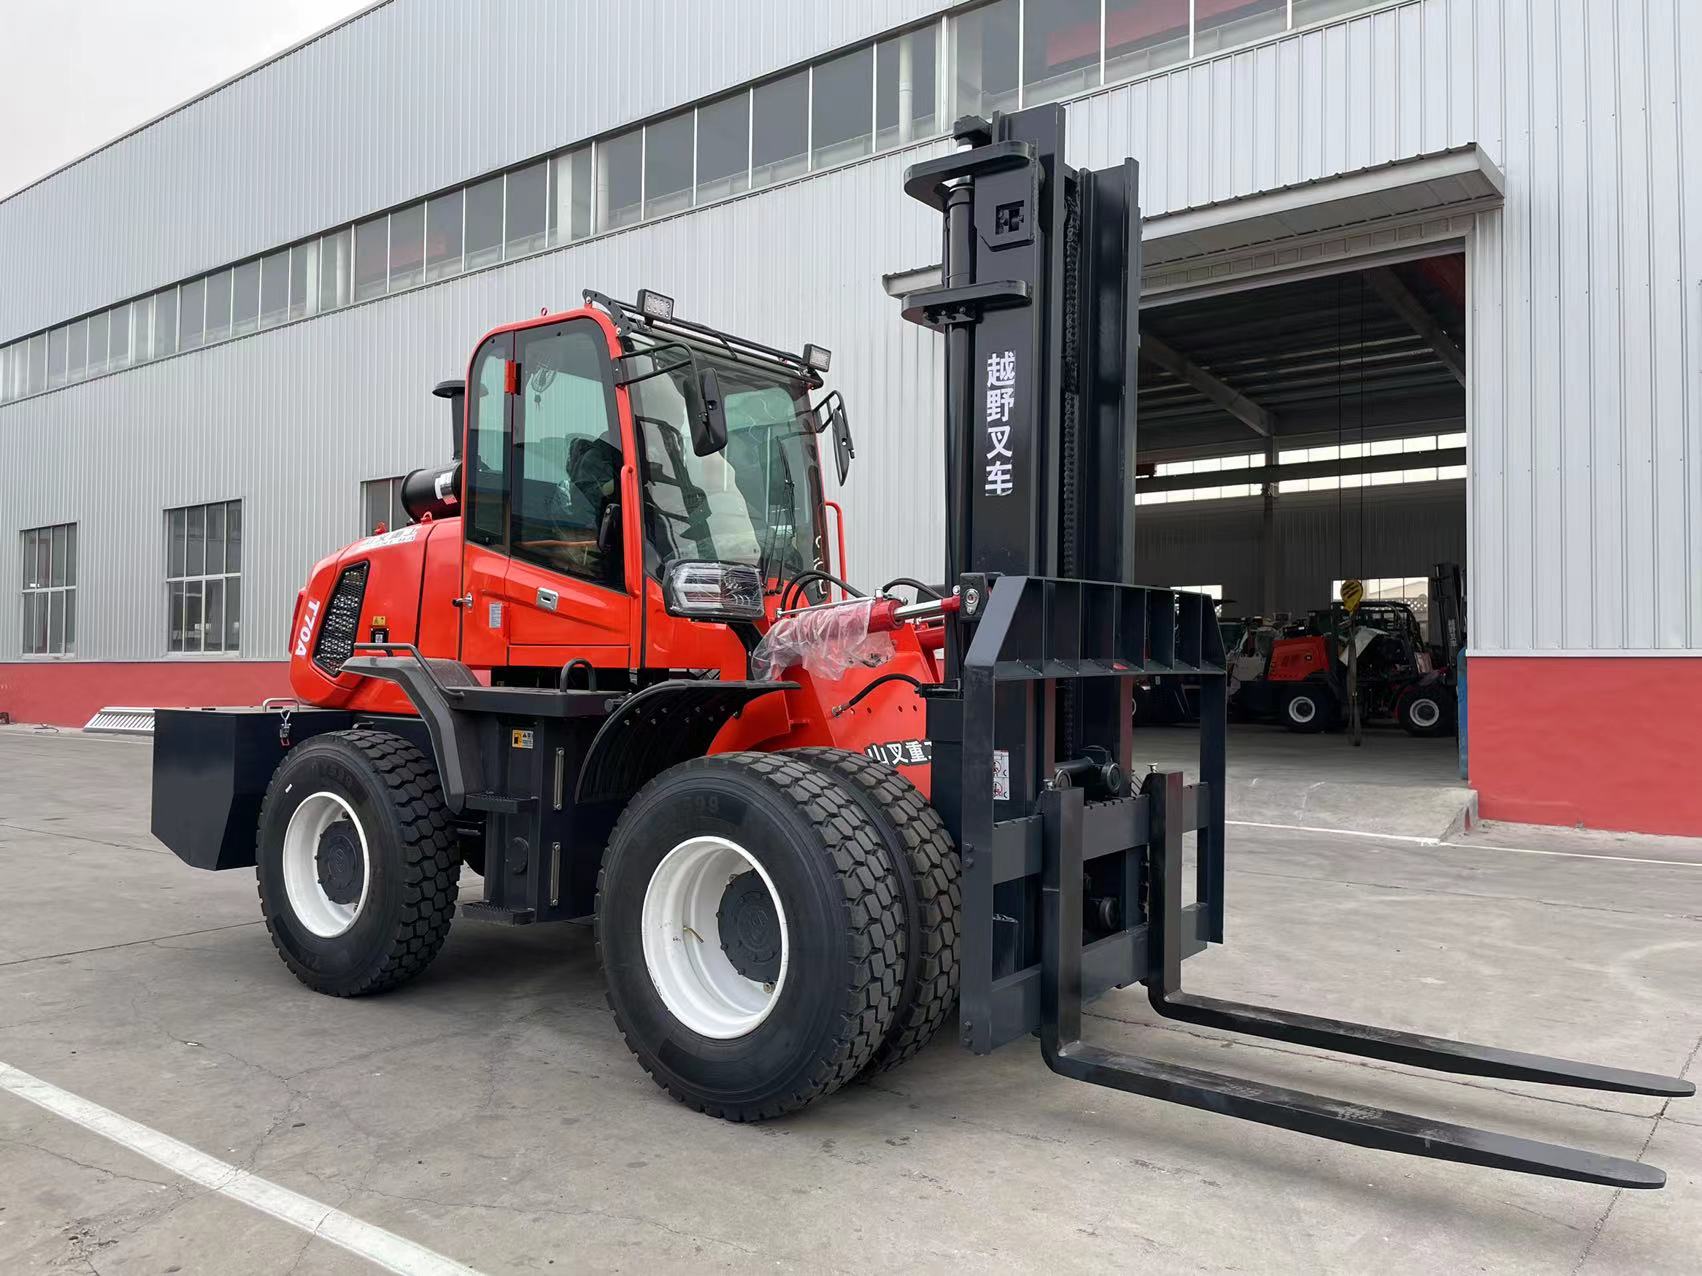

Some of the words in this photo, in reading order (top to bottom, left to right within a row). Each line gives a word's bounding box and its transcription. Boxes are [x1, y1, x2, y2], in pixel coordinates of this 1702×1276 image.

[985, 351, 1015, 496] 越野叉车
[295, 600, 320, 656] T70A
